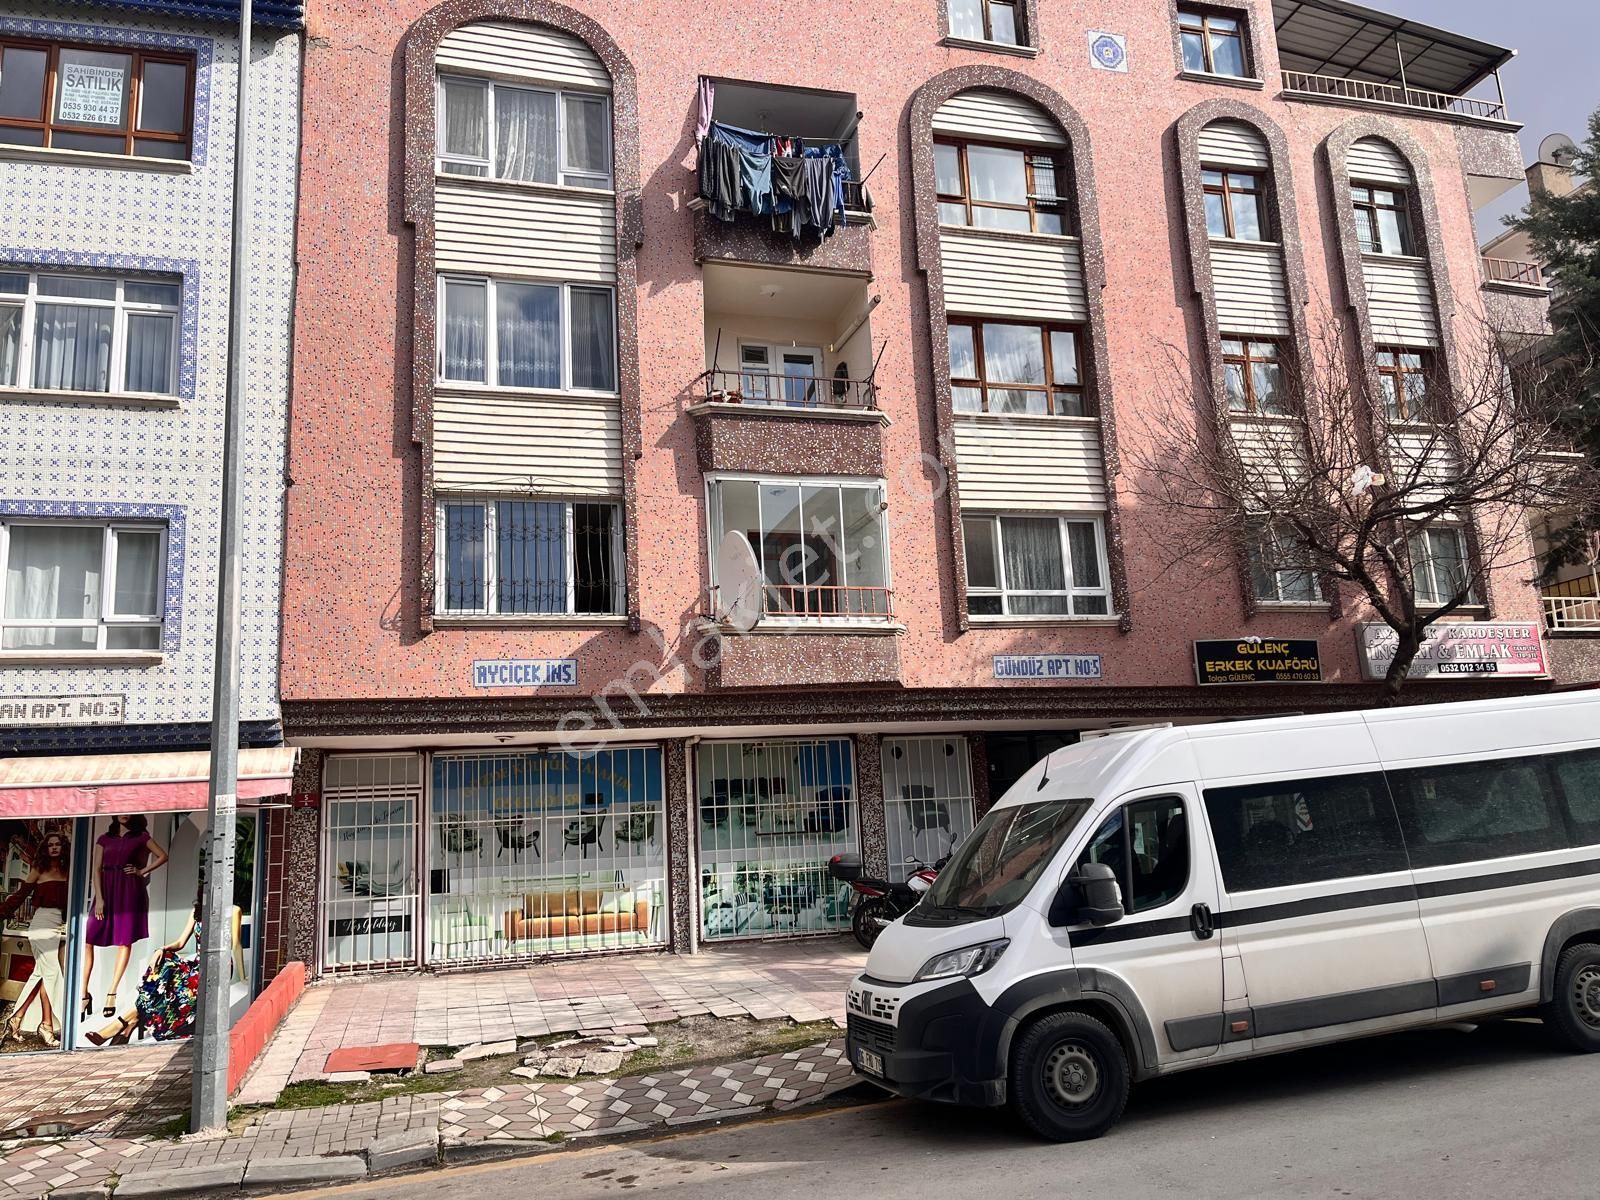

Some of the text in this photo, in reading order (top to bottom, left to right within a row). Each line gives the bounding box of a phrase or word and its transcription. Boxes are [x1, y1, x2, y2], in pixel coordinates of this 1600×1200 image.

[66, 74, 121, 92] SATILIK
[62, 111, 80, 120] 0532
[82, 113, 96, 121] 526
[63, 102, 119, 114] 0535 930 44 37
[1448, 628, 1531, 642] KARDEŞLER
[1437, 643, 1450, 659] &
[1454, 643, 1513, 660] EMLAK
[995, 657, 1044, 676] GÜNDÜZ
[1074, 659, 1099, 676] NO:5
[1205, 657, 1317, 672] ERKEK KUAFÖRÜ
[1440, 663, 1496, 672] 0532 012 34 55
[476, 662, 541, 684] AYÇİÇEK
[31, 702, 72, 719] APT.
[79, 701, 120, 718] NO:3
